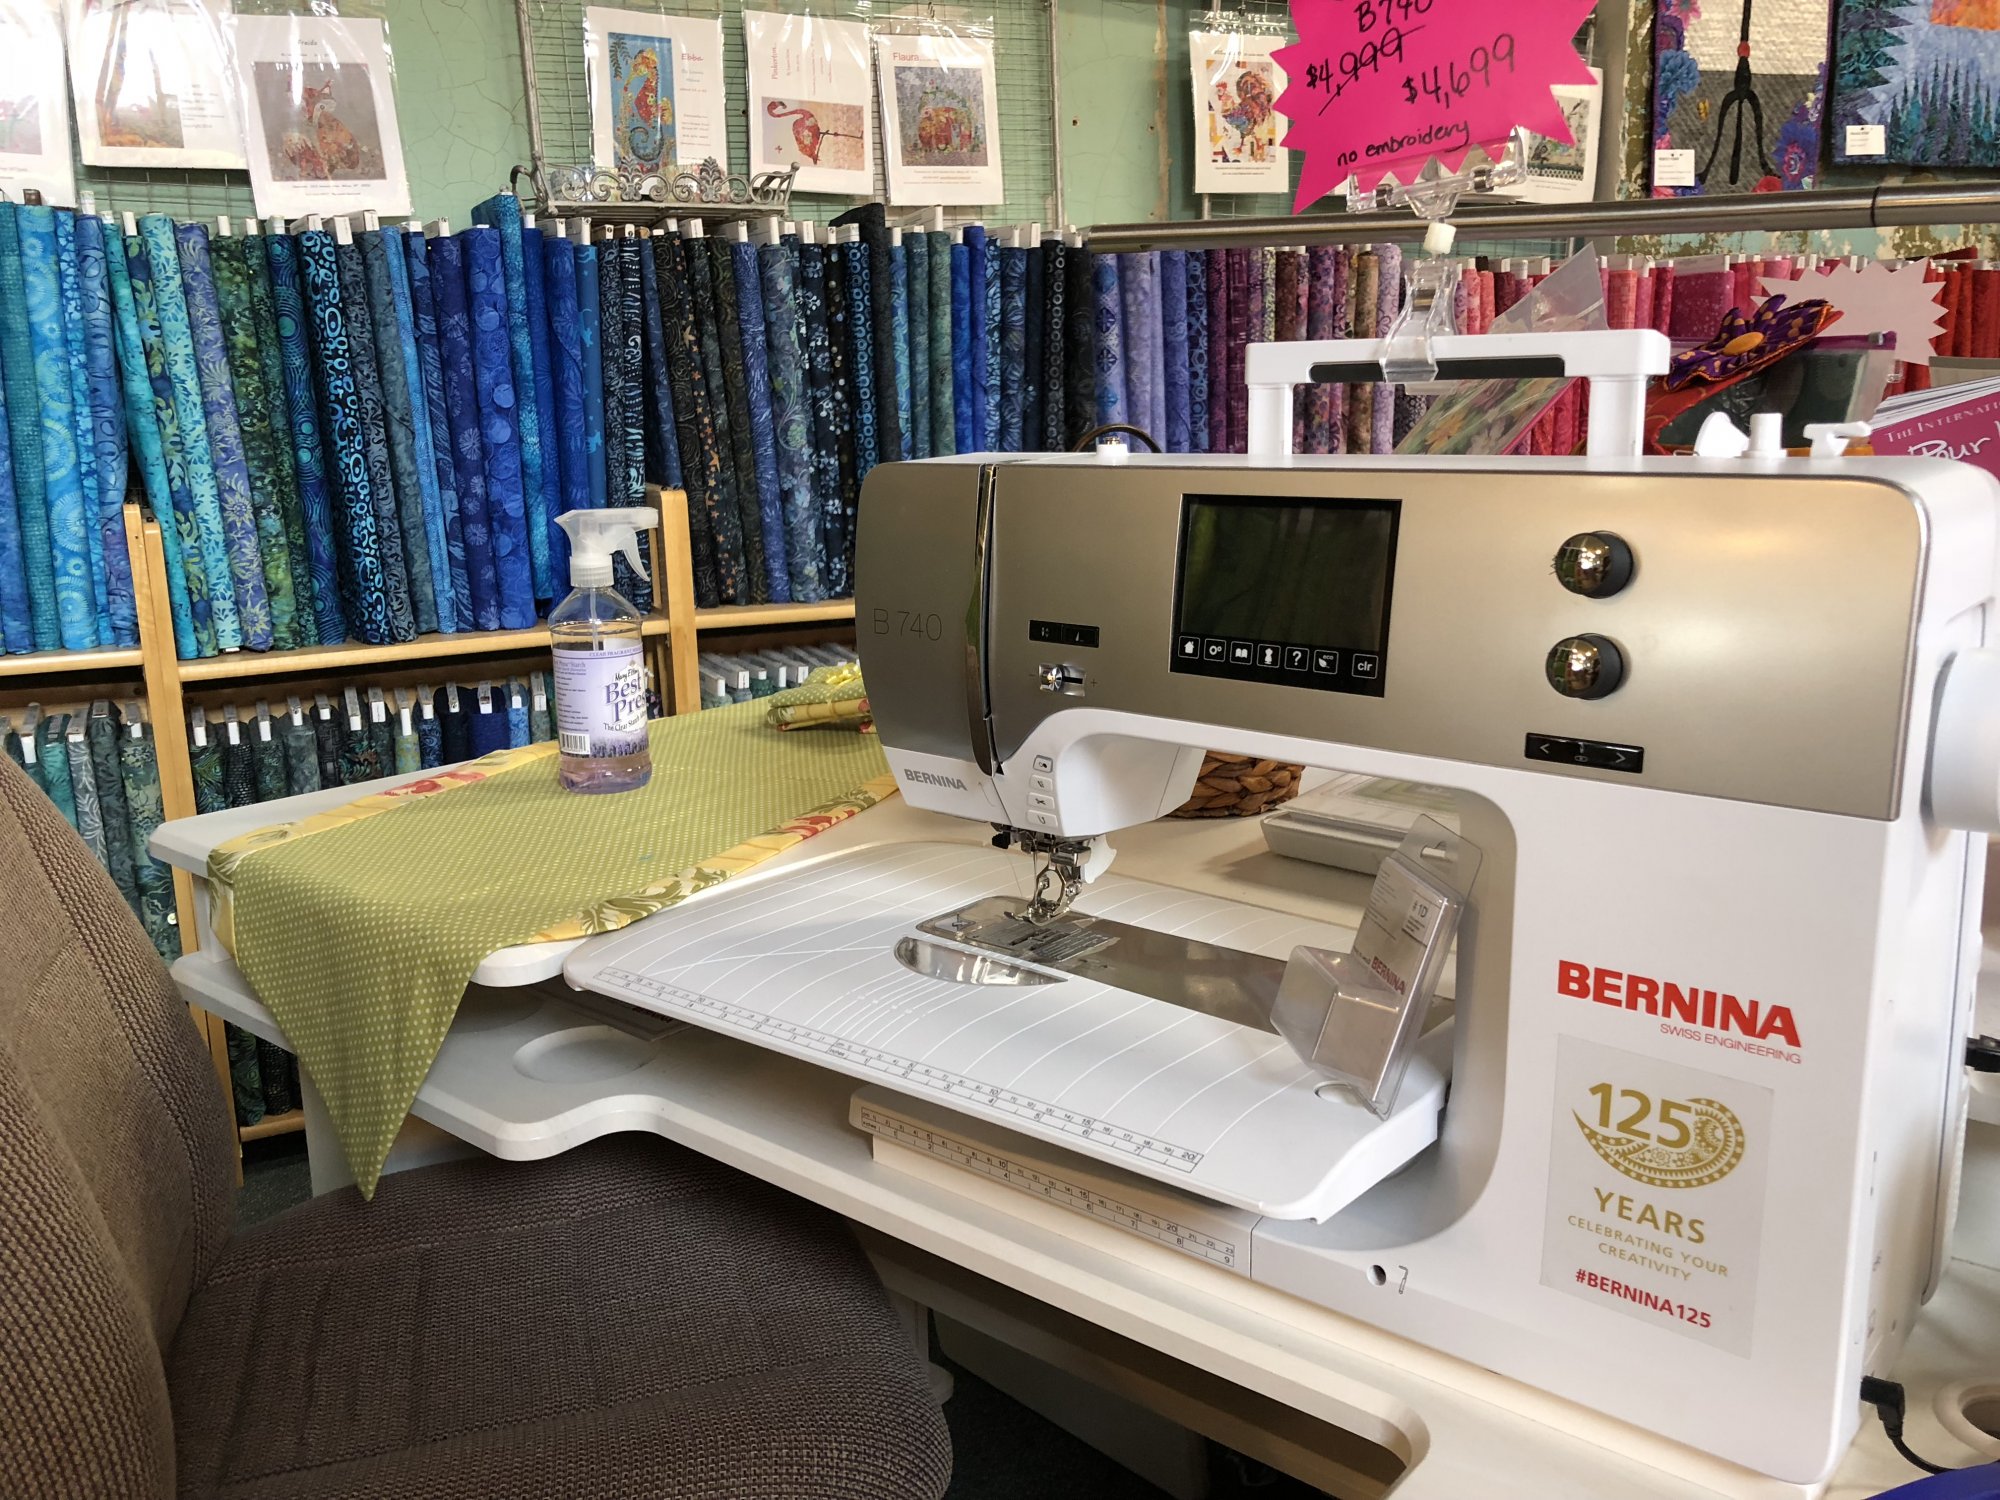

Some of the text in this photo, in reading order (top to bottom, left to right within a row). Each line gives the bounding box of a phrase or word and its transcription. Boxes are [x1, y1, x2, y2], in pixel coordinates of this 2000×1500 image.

[1402, 33, 1515, 109] $4,699
[1337, 121, 1470, 166] no embroidery
[1917, 401, 2000, 433] INTERNATI
[1907, 439, 1992, 461] Pour
[873, 608, 942, 641] B 740
[1357, 661, 1373, 672] clr
[605, 673, 642, 704] Best
[614, 691, 646, 723] Pres
[603, 722, 614, 731] The
[904, 768, 968, 791] BERNINA
[1371, 956, 1406, 995] BERNINA
[1557, 959, 1802, 1048] BERNINA
[1660, 1023, 1802, 1065] SWISS ENGINEERING
[1588, 1082, 1692, 1149] 125
[1182, 1151, 1195, 1160] 20
[999, 1160, 1006, 1168] 10
[1166, 1223, 1178, 1233] 20
[1593, 1187, 1705, 1244] YEARS
[1224, 1255, 1230, 1263] 9
[1567, 1215, 1729, 1277] CELEBRATING YOUR
[1598, 1242, 1692, 1281] CREATIVITY
[1575, 1268, 1712, 1329] #BERNINA125
